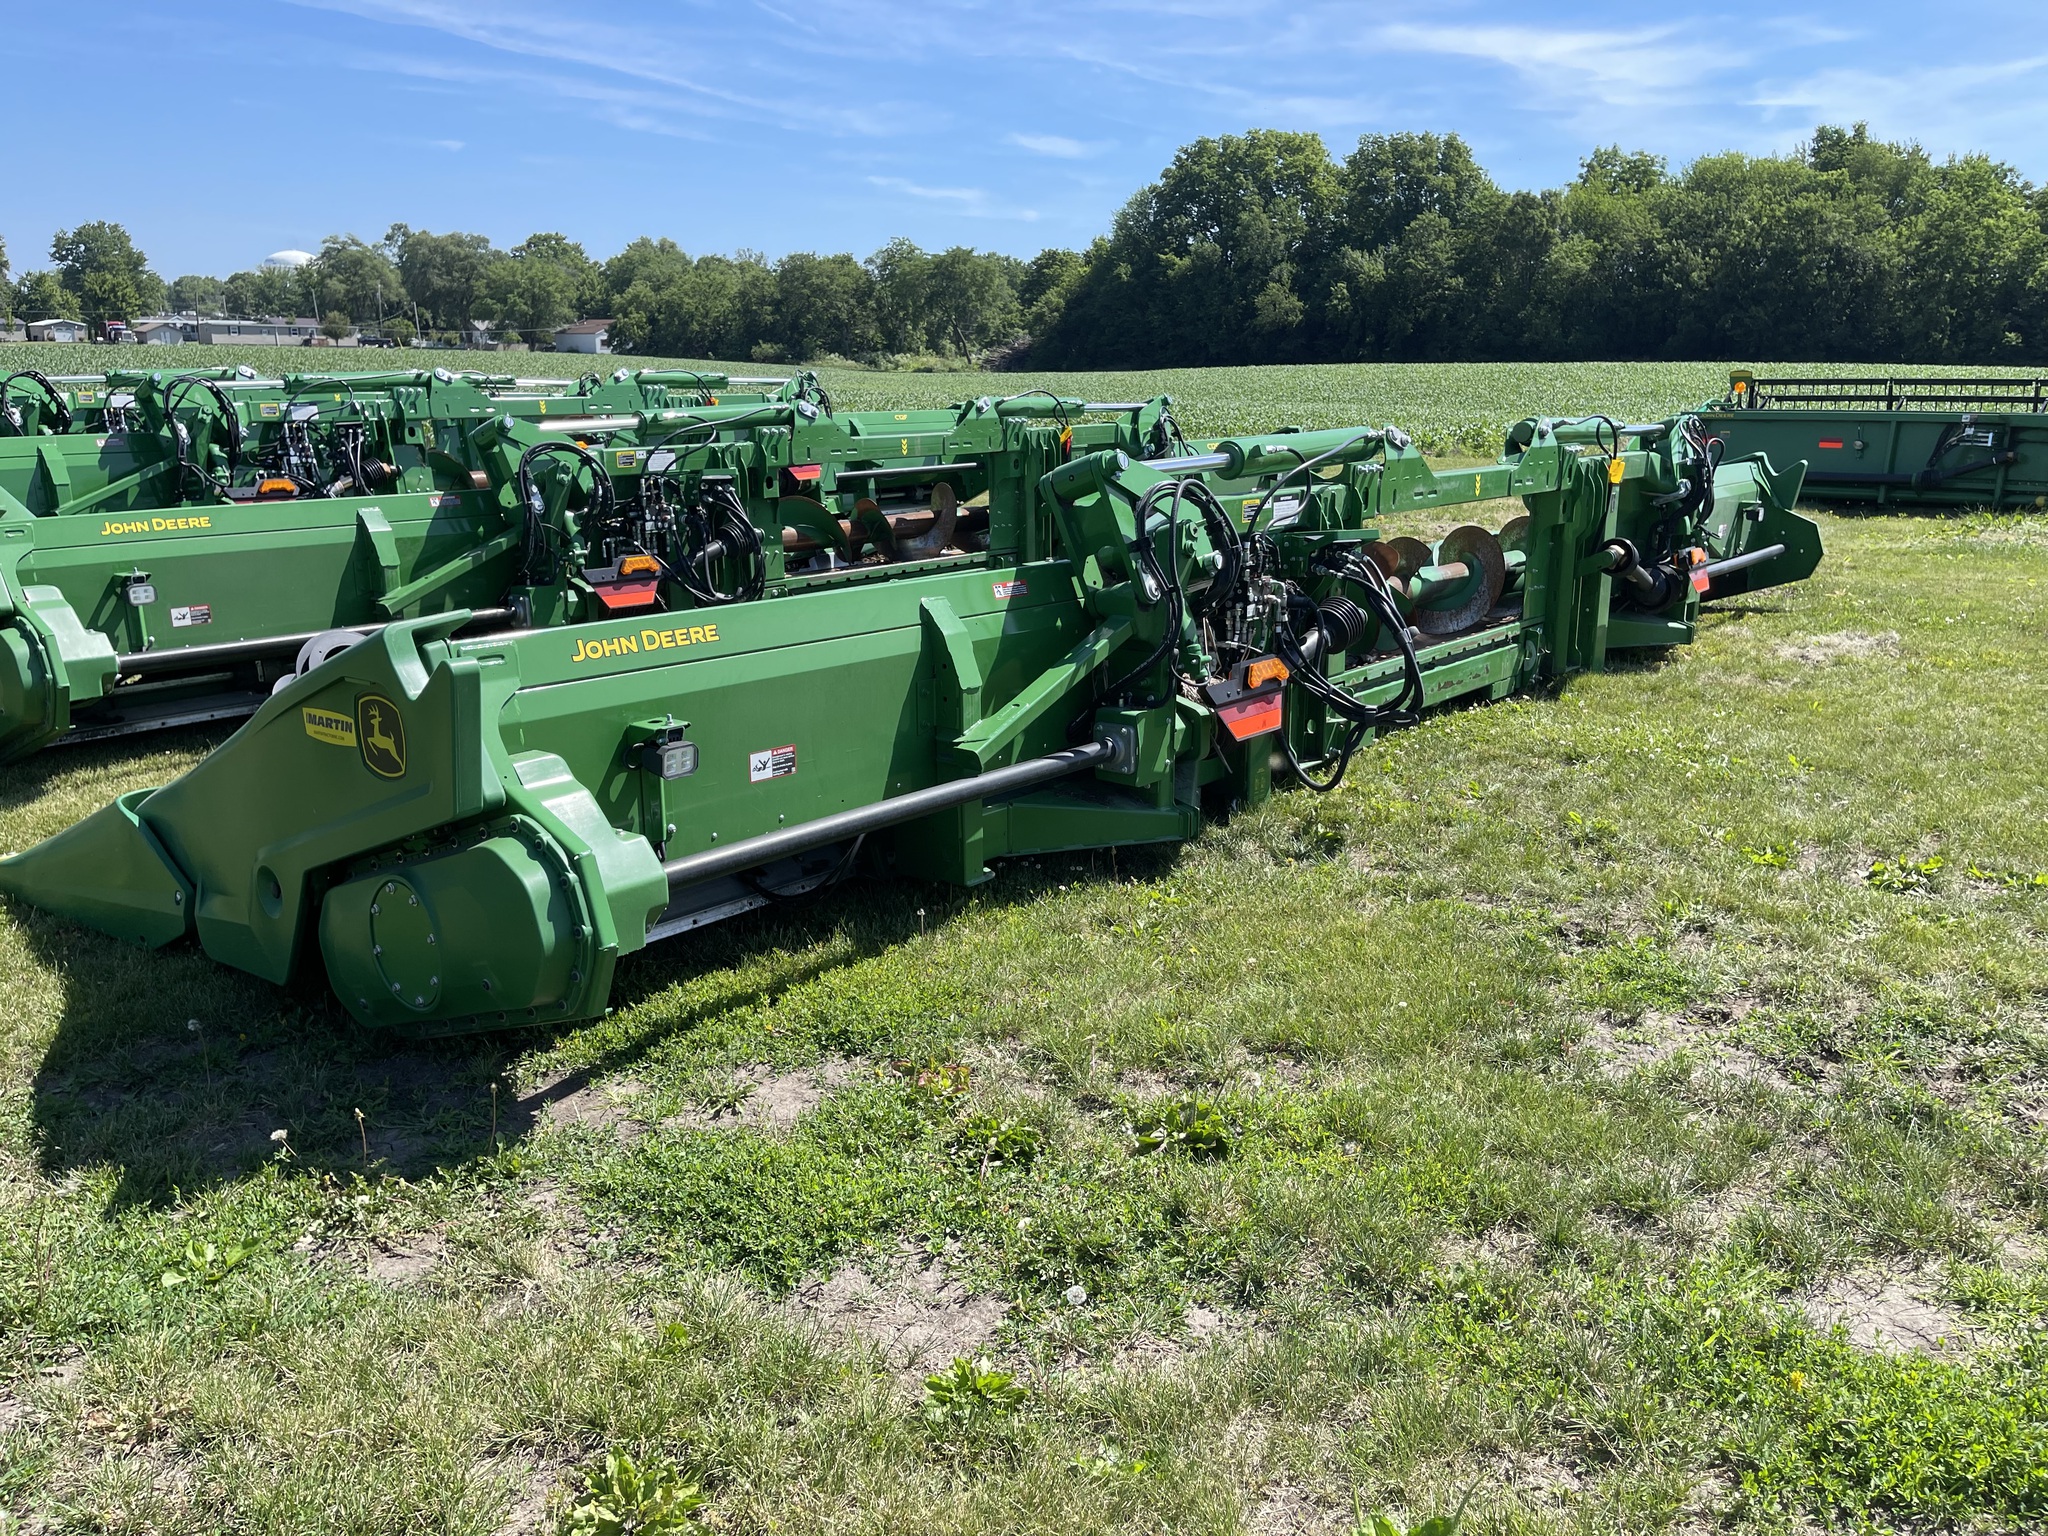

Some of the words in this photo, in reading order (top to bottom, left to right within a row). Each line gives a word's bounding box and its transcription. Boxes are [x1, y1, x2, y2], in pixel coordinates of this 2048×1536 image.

[101, 521, 150, 535] JOHN
[151, 516, 212, 531] DEERE
[571, 635, 639, 662] JOHN
[640, 624, 720, 651] DEERE
[306, 712, 353, 734] MARTIN
